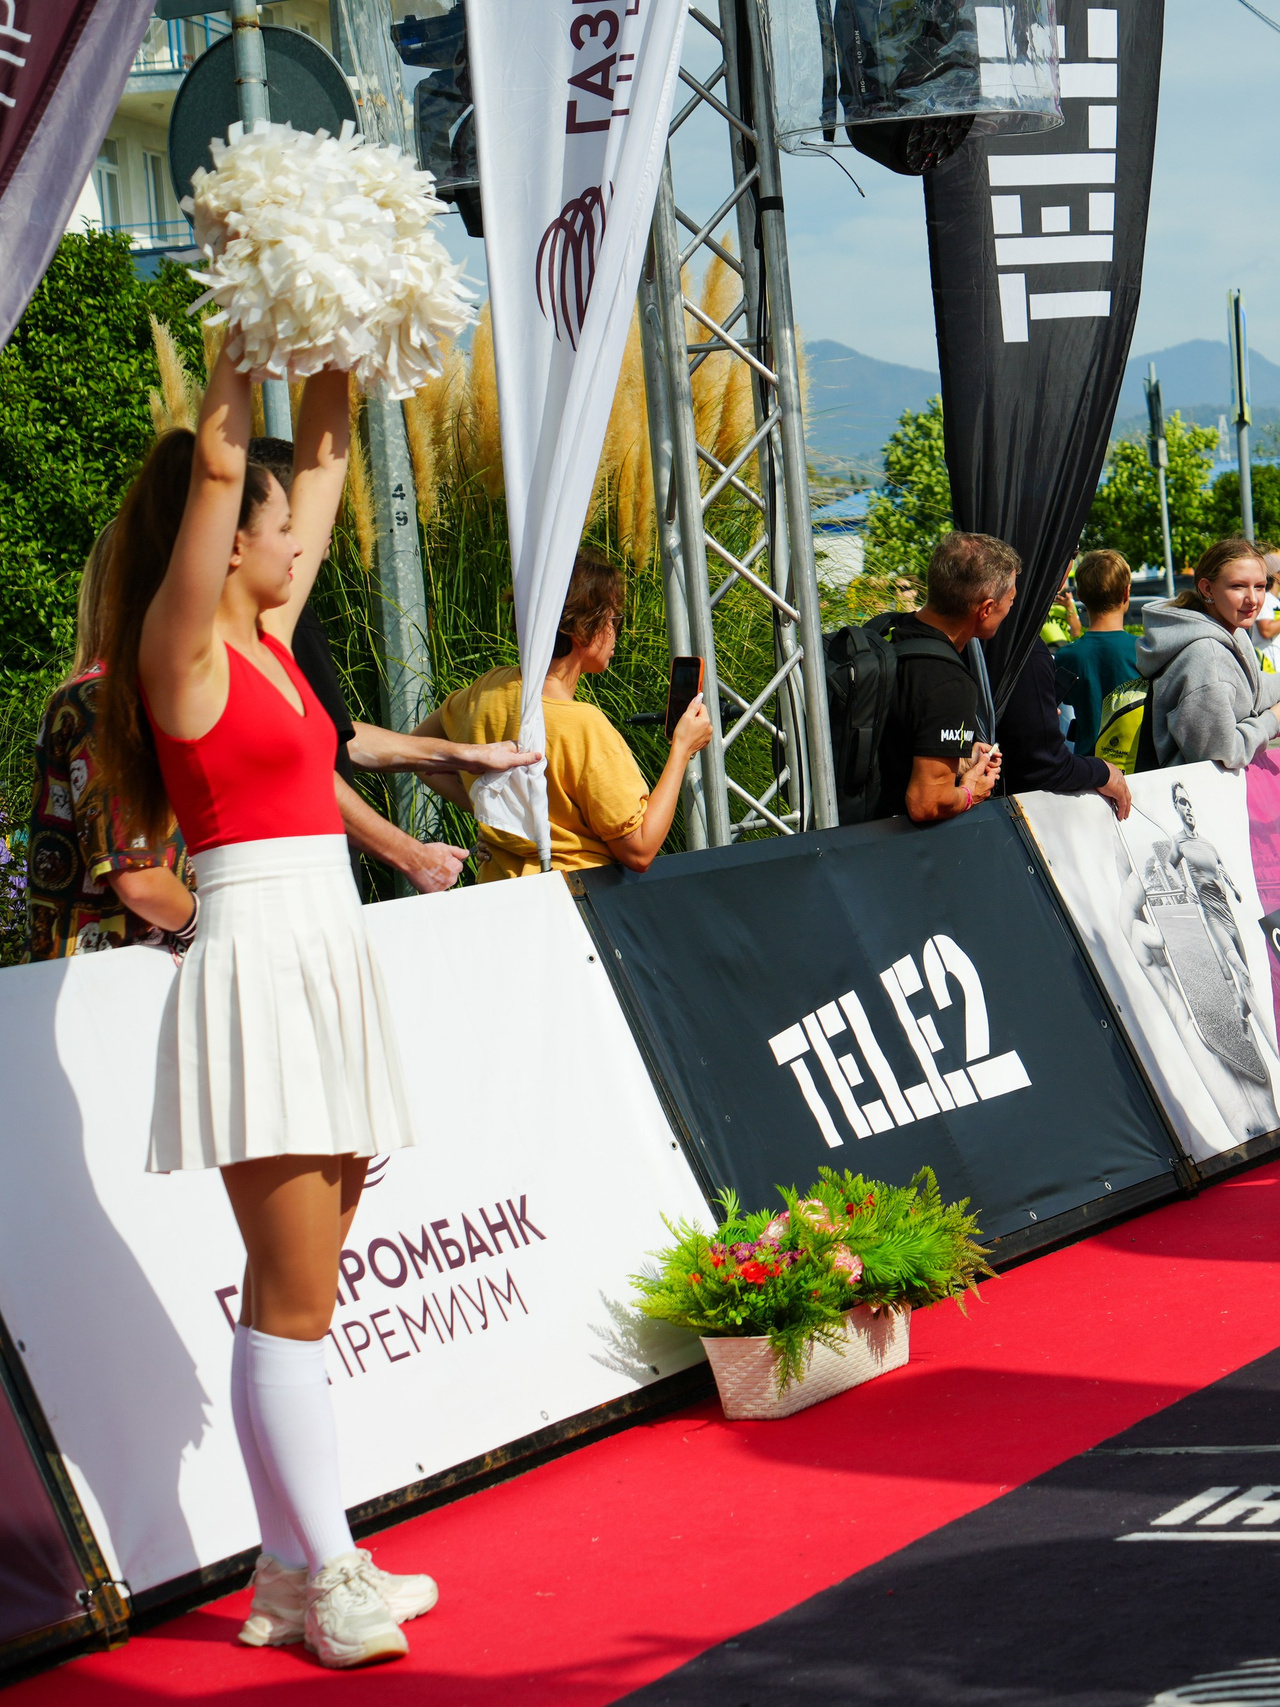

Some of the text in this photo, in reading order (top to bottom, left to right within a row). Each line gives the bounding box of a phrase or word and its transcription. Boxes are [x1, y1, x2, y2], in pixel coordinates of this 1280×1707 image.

[565, 0, 619, 134] ГАЗ
[768, 934, 1033, 1149] TELE2
[214, 1194, 547, 1335] ГРОМБАНК
